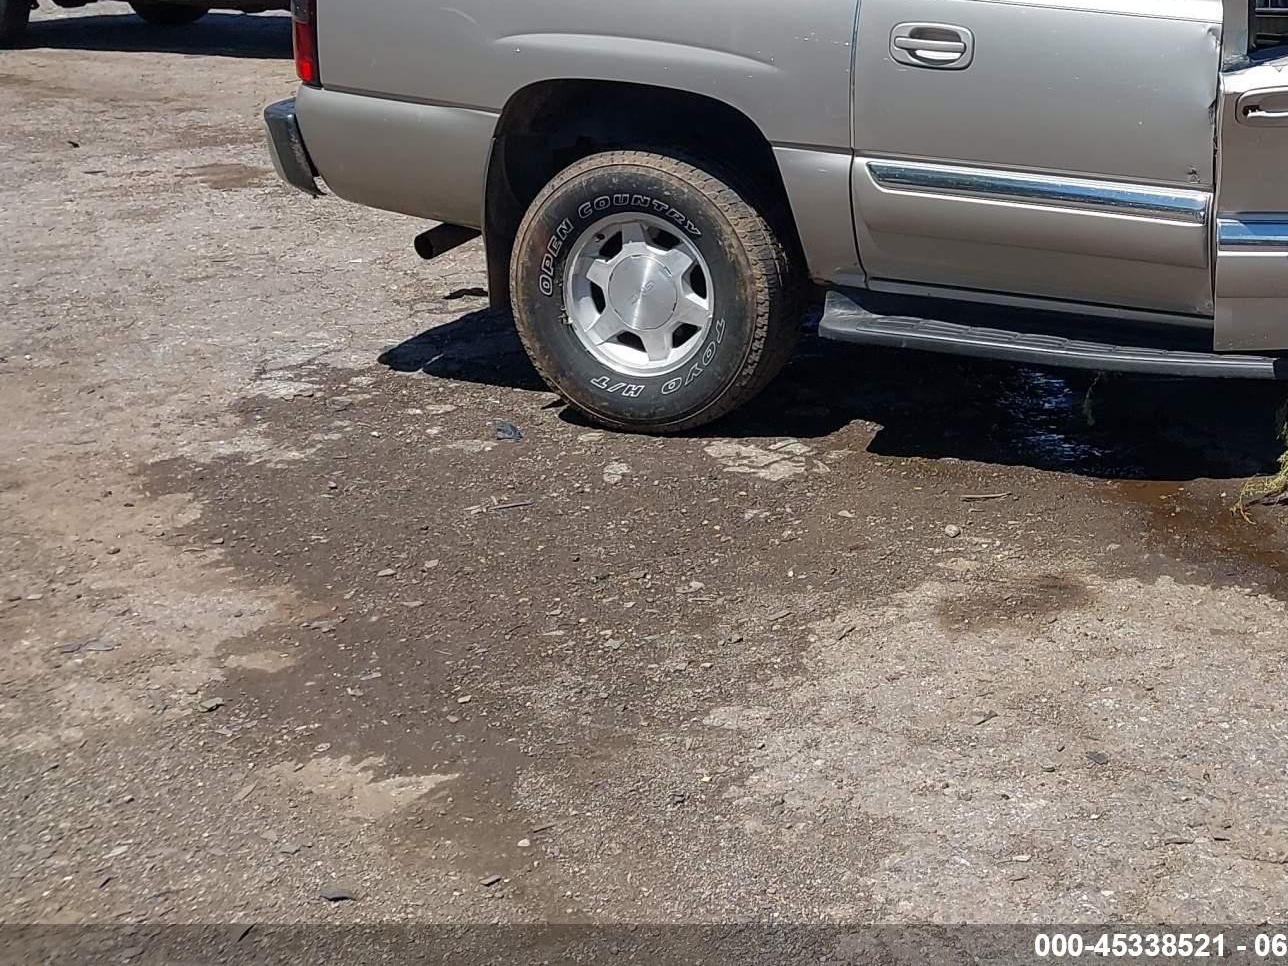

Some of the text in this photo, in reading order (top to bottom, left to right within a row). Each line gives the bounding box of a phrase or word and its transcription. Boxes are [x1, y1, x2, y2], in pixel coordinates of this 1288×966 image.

[539, 193, 702, 295] OPEN COUNTRY
[591, 375, 645, 397] H/T
[661, 317, 726, 395] TOYO
